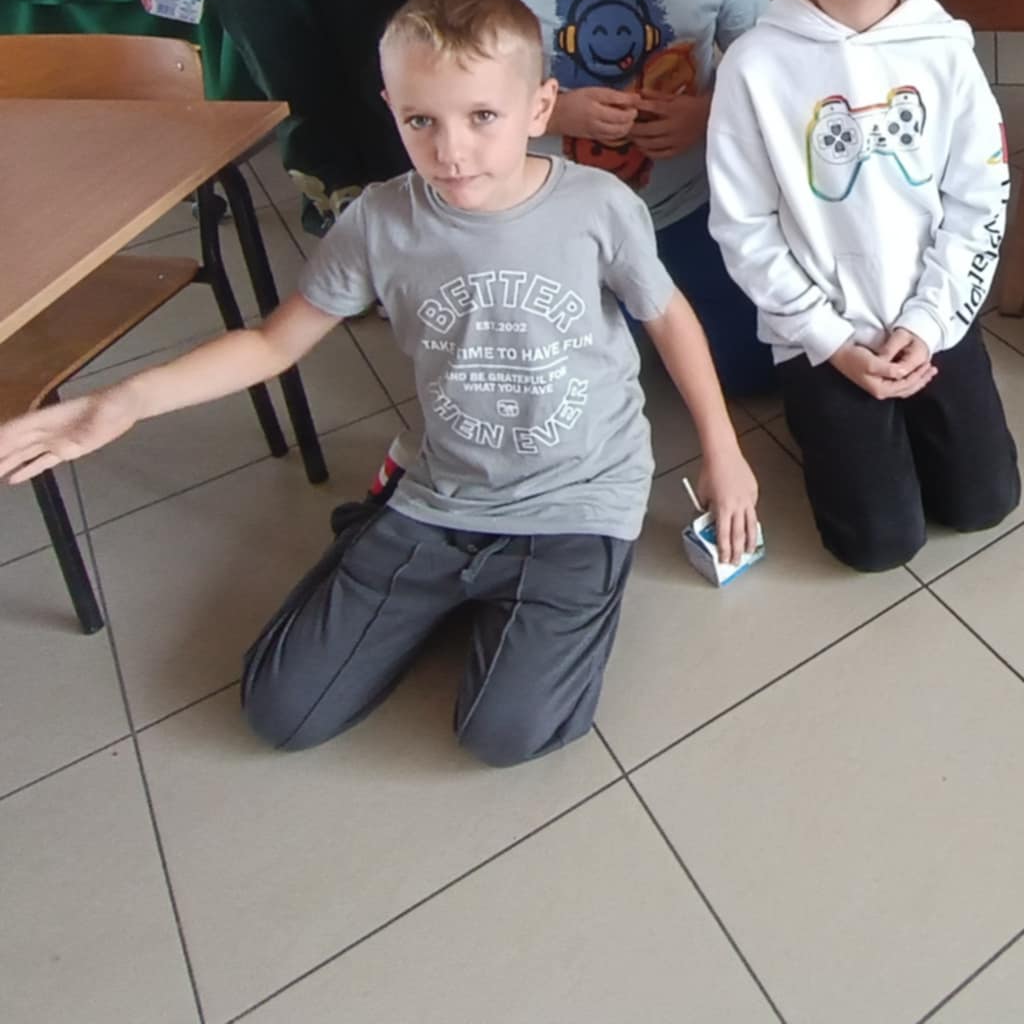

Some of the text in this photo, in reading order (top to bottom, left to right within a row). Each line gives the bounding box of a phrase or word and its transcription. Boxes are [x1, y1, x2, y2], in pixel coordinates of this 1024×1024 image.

[417, 270, 586, 334] BETTER
[456, 346, 494, 360] TIME
[496, 347, 518, 361] TO
[522, 341, 561, 362] HAVE
[563, 332, 594, 352] FUN
[463, 382, 495, 393] WHAT
[498, 382, 522, 394] YOU
[469, 371, 486, 382] BE
[512, 377, 590, 454] EVER
